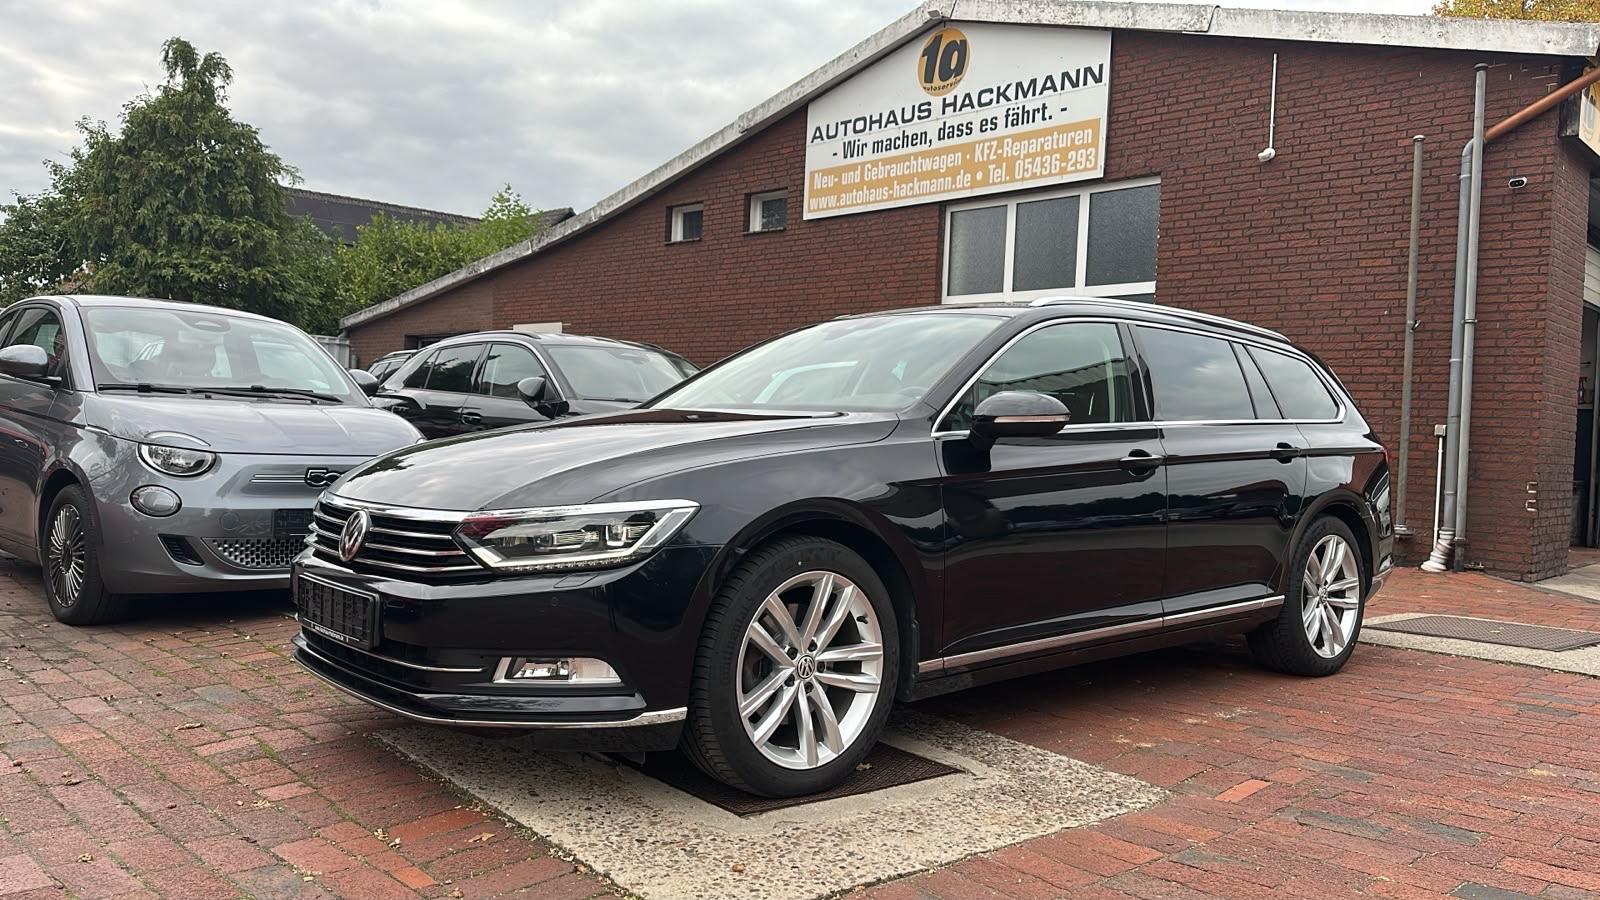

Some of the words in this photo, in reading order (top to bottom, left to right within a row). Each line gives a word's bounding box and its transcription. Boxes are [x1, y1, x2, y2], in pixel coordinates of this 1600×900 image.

[921, 34, 968, 84] 1a
[810, 101, 932, 143] AUTOHAUS
[942, 63, 1104, 115] HACKMANN
[843, 139, 867, 159] Wir
[872, 130, 932, 148] machen,
[938, 121, 973, 141] dass
[980, 116, 998, 133] es
[1004, 103, 1053, 128] fährt.
[809, 170, 971, 210] www.autohaus-hackmann.de
[988, 162, 1010, 184] Tel.
[1015, 147, 1096, 180] 05436-293
[814, 172, 838, 190] Neu-
[841, 165, 860, 184] und
[864, 152, 961, 182] Gebrauchtwagen
[974, 128, 1092, 162] KFZ-Reparaturen
